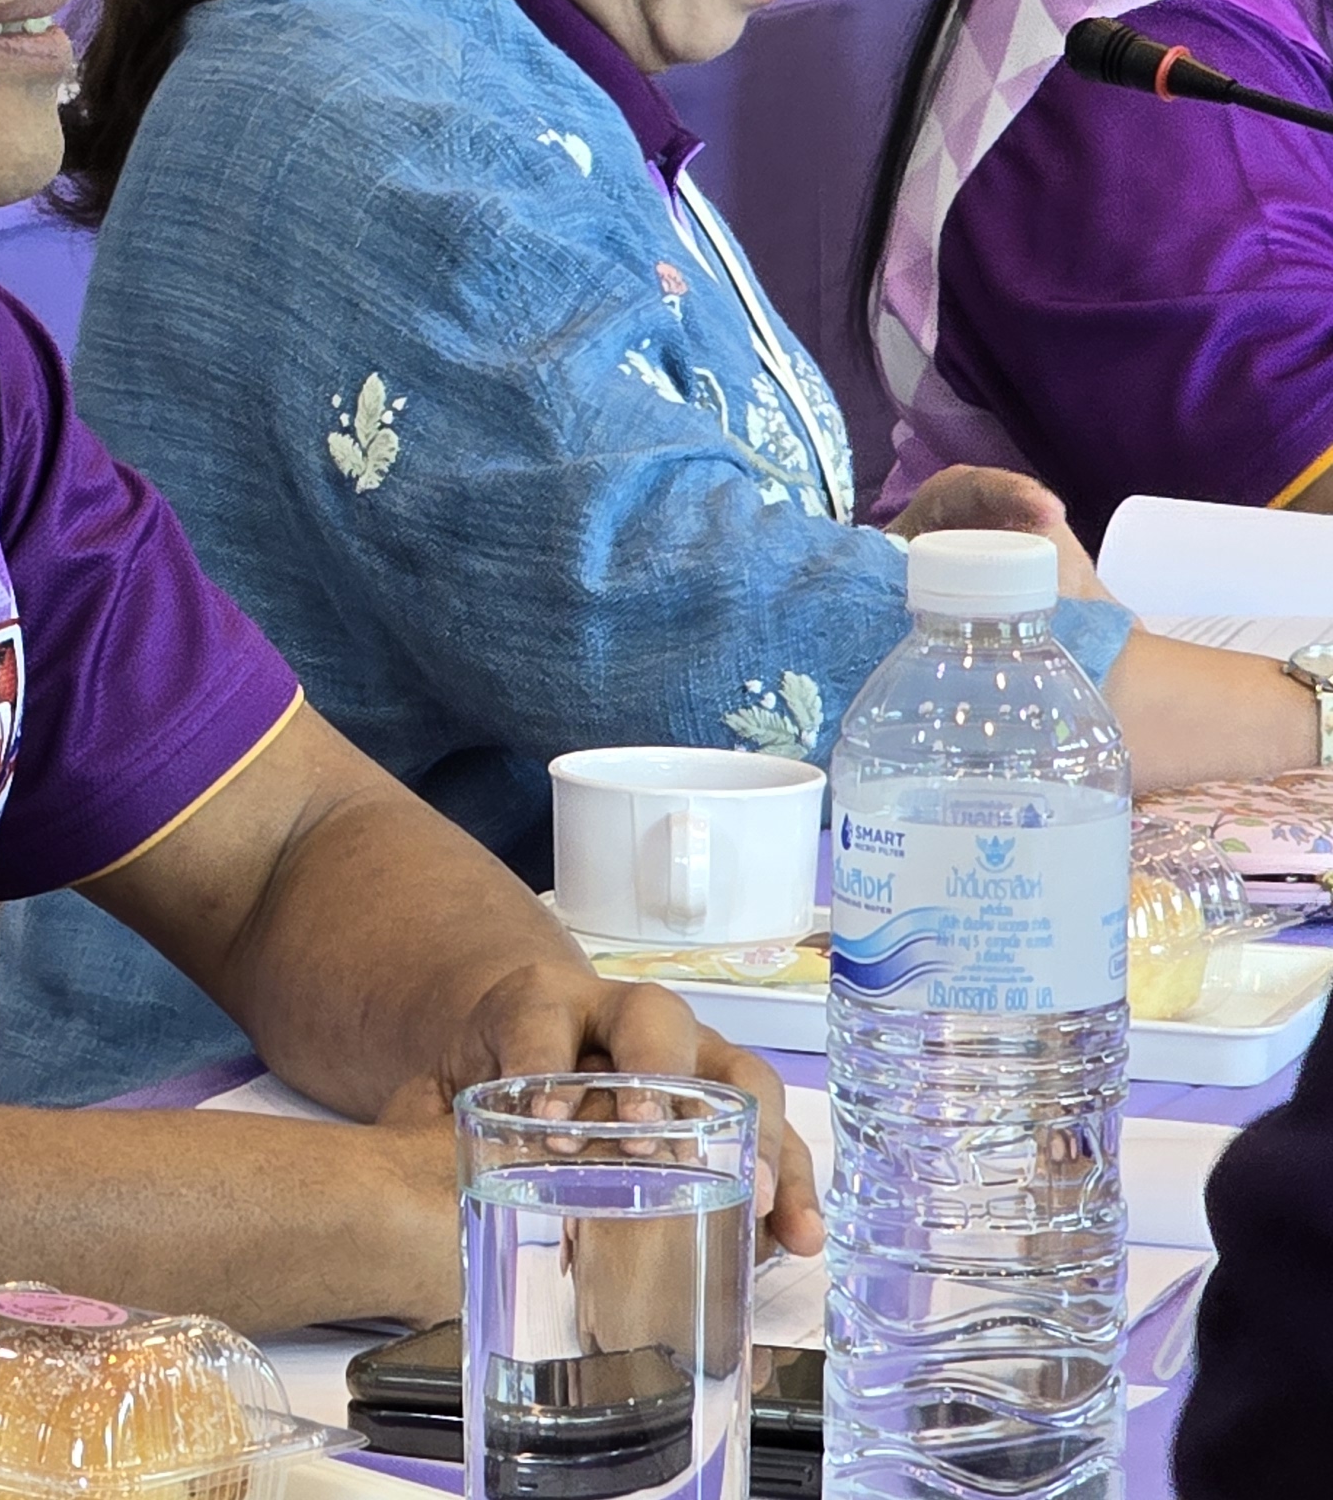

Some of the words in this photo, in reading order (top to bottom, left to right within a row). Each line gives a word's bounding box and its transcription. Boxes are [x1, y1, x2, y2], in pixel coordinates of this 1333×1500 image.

[855, 824, 906, 848] SMART
[854, 842, 876, 853] MICRO
[878, 846, 905, 858] FILTER
[1005, 987, 1028, 1011] 600
